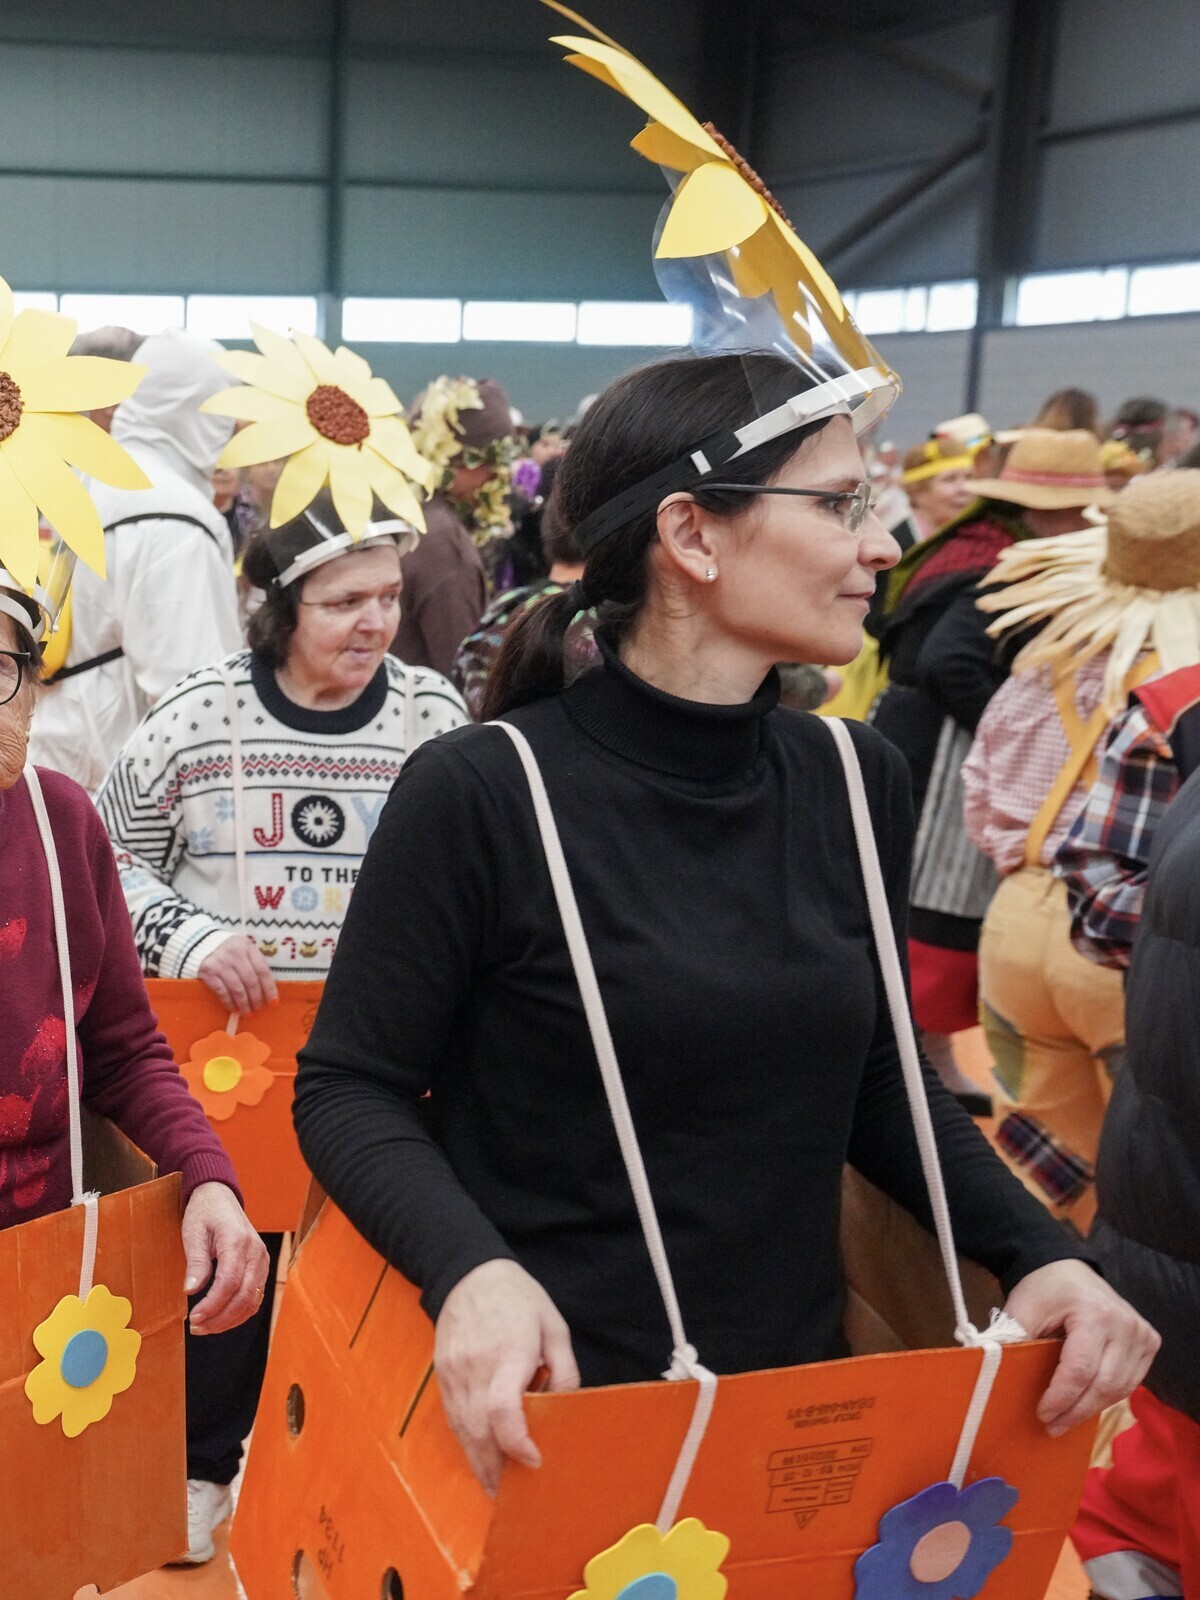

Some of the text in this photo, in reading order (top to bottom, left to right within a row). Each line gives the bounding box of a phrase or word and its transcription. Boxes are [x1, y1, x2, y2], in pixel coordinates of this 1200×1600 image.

[254, 793, 388, 848] JOY
[285, 866, 312, 882] TO
[255, 886, 353, 912] WOR
